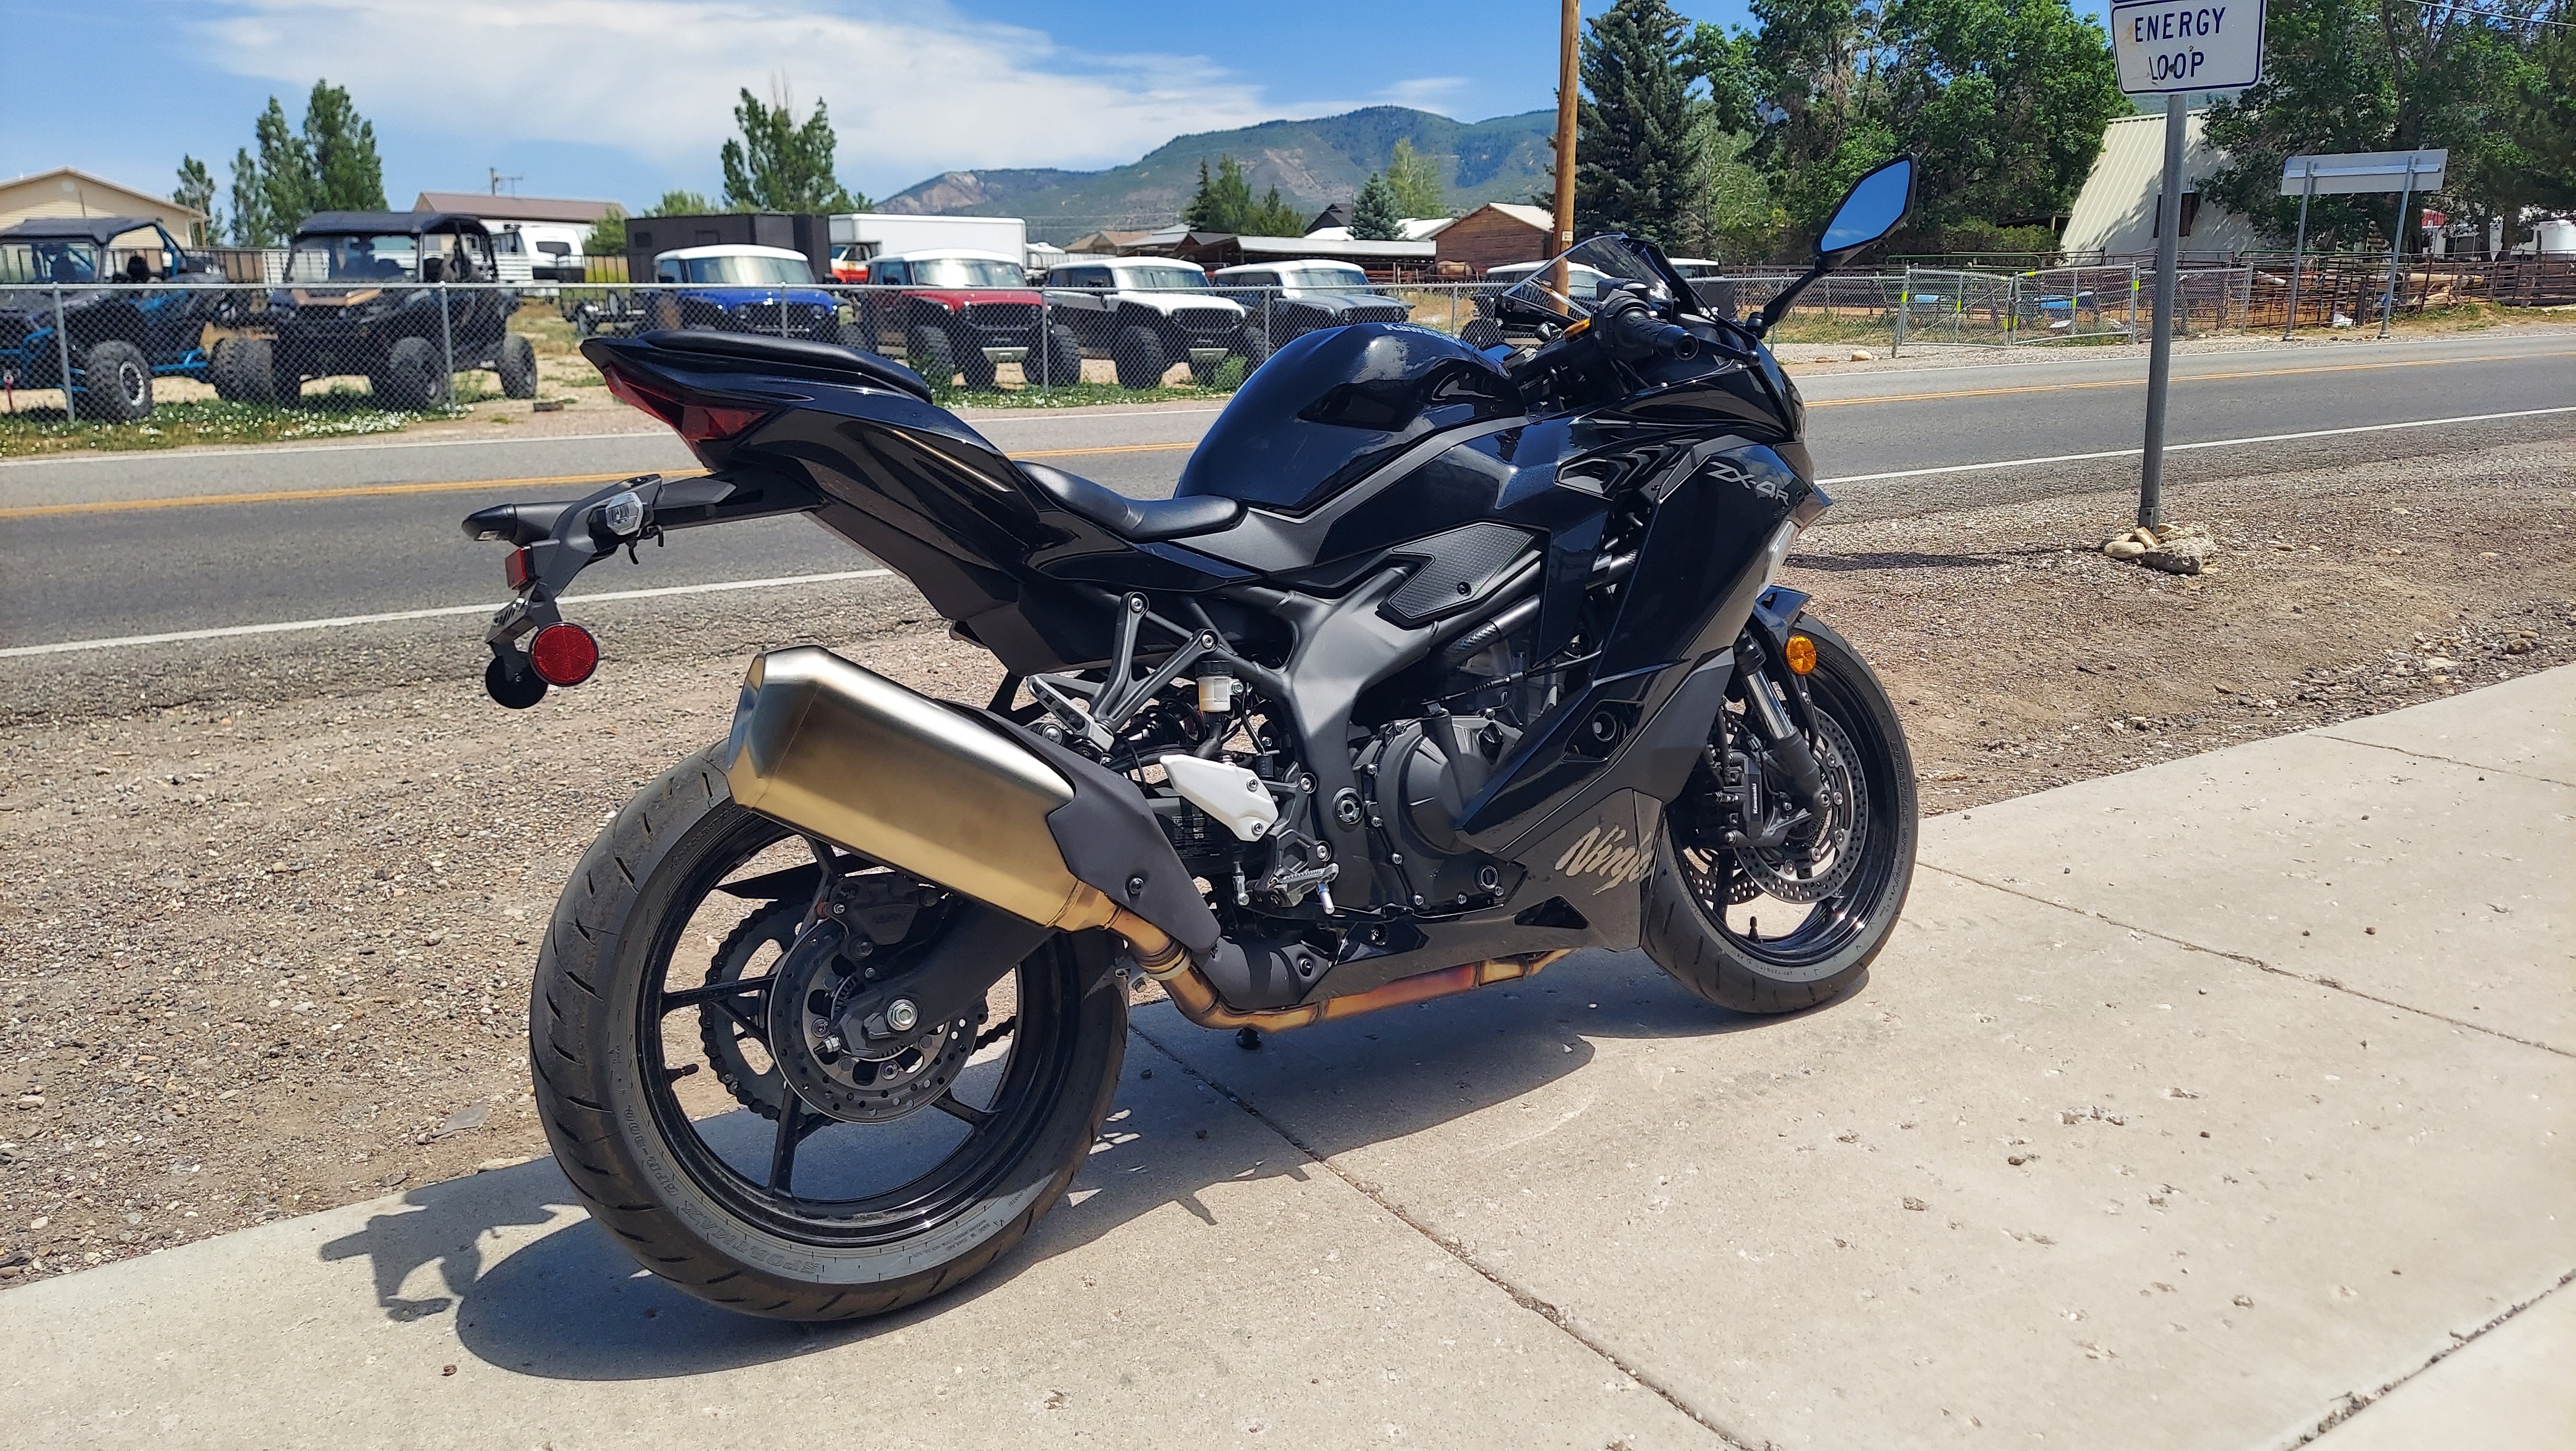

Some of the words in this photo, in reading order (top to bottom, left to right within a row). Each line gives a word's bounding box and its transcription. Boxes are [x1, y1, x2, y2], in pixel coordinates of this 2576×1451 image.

[2135, 7, 2226, 42] ENERGY
[2148, 51, 2204, 80] LOOP
[1381, 324, 1463, 348] Kawasaki
[1706, 461, 1789, 506] ZX-4R
[1554, 824, 1654, 896] Ninja
[624, 1108, 679, 1196] GPR-300
[681, 1202, 821, 1274] SPORTMAX
